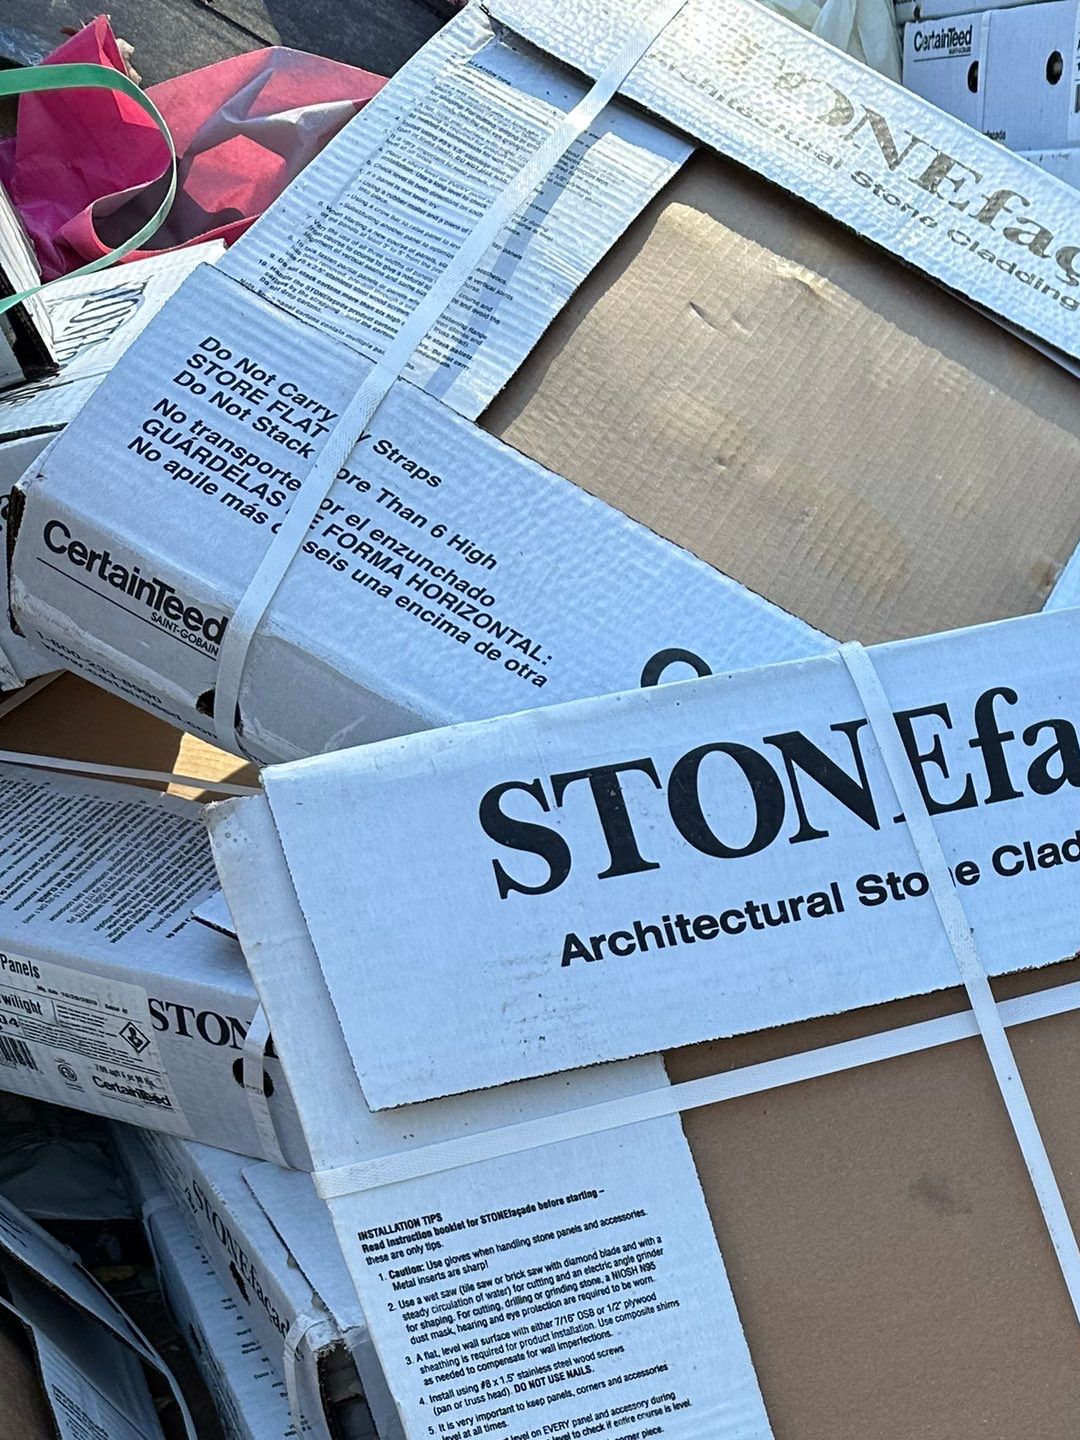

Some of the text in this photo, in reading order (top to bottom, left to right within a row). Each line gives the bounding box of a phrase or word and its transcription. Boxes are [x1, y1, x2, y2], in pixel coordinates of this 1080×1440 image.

[914, 25, 973, 53] CertainTeed
[947, 228, 1080, 312] Cladding
[187, 353, 329, 438] STORE FLAT
[198, 336, 441, 487] Do Not Carry Straps
[152, 398, 495, 606] No transporte or el enzunchado
[173, 370, 497, 570] Do Not Stack ore Than 6 High
[43, 520, 229, 645] CertainTeed
[127, 436, 547, 688] No apile más seis una encima de otra
[143, 419, 286, 507] GUÁRDELAS
[321, 523, 404, 580] FORMA
[405, 573, 552, 665] HORIZONTAL:
[151, 611, 220, 657] SAINT-GOBAIN
[560, 882, 845, 967] Architectural
[855, 857, 981, 907] Stoe
[1, 954, 41, 980] Panels
[1, 993, 43, 1016] wilight
[357, 1213, 442, 1241] INSTALLATION TIPS
[361, 1240, 385, 1253] Read
[386, 1230, 433, 1247] Instruction
[433, 1220, 466, 1236] booklet
[466, 1218, 478, 1227] for
[537, 1197, 564, 1210] before
[565, 1190, 598, 1203] starting
[378, 1209, 647, 1281] 1. Caution: Use gloves when handling stone panels and accessories.
[392, 1259, 488, 1291] Metal inserts are sharp!
